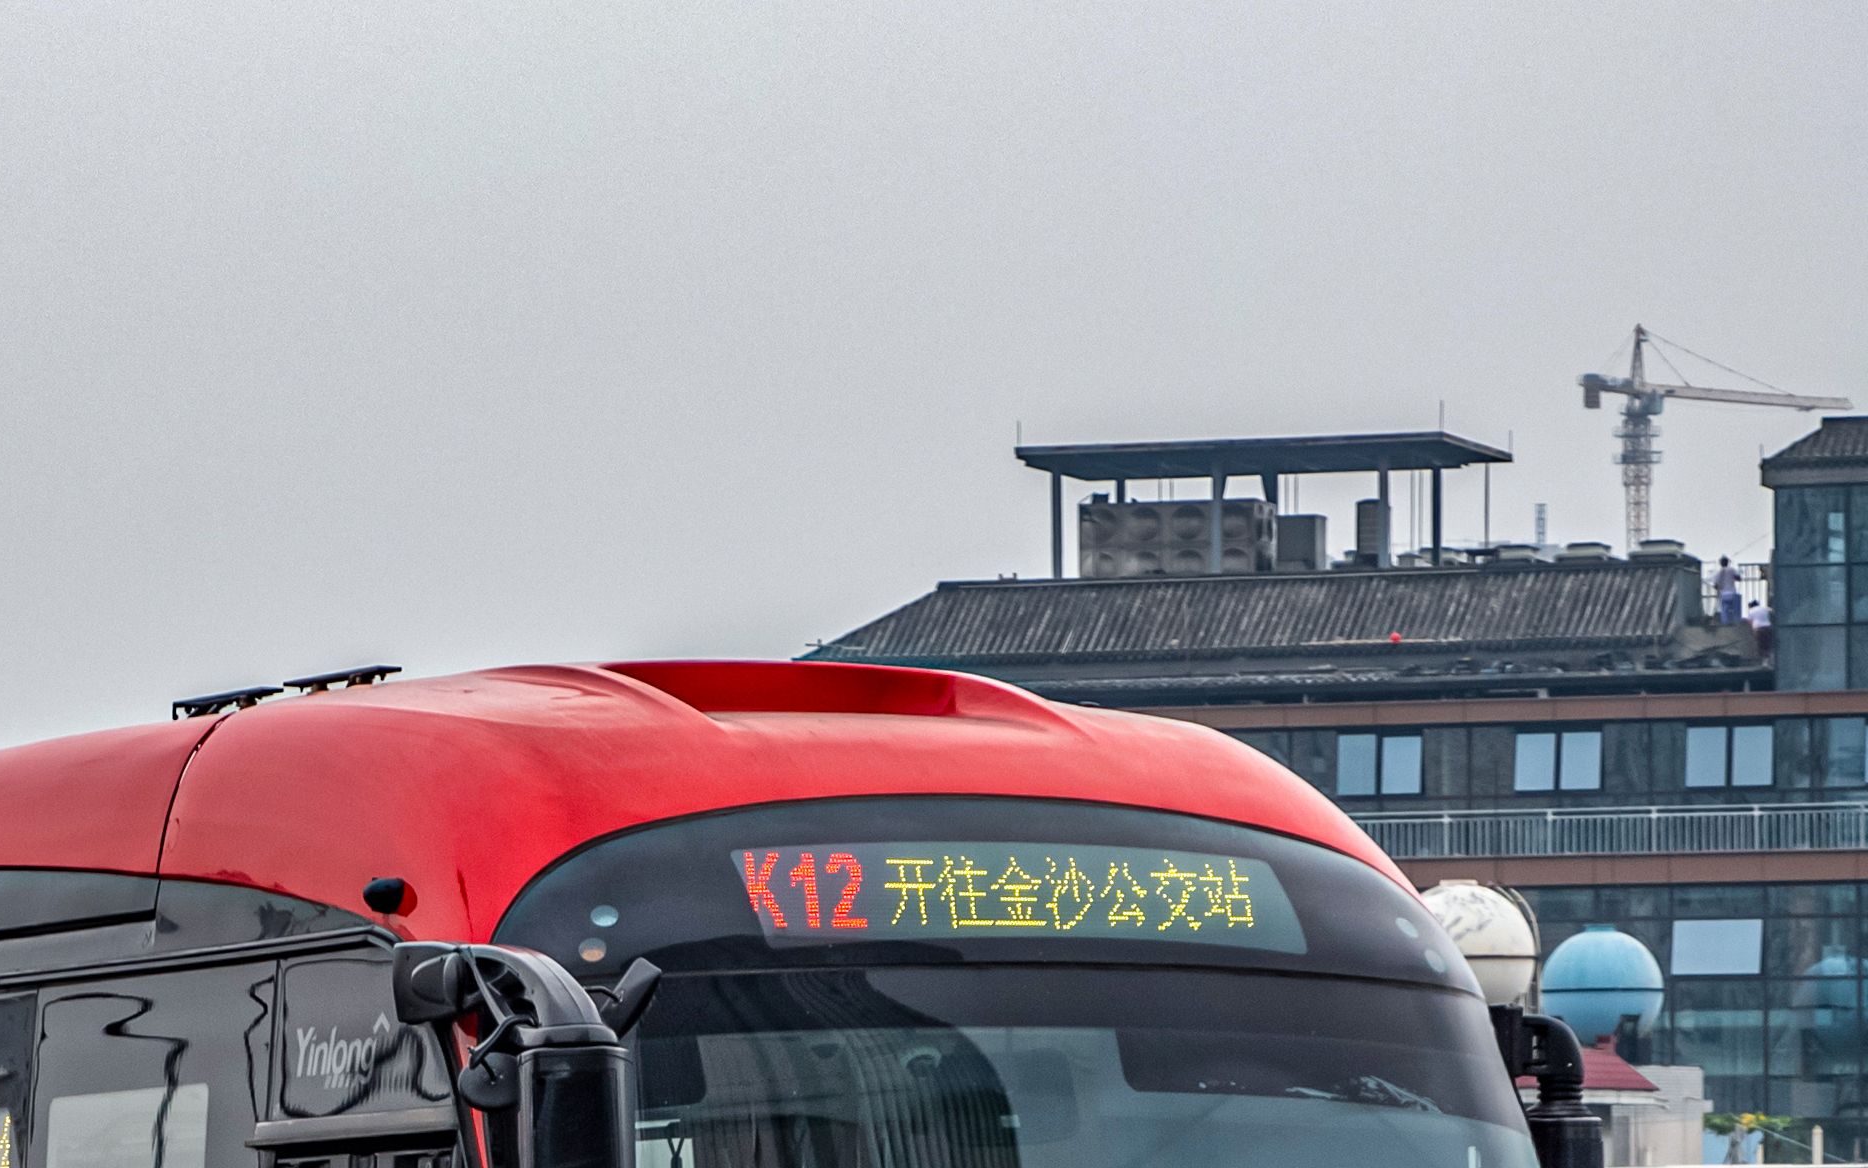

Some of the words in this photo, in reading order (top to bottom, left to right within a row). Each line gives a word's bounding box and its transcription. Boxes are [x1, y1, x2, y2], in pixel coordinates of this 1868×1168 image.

[742, 852, 867, 928] K12
[885, 855, 1254, 930] 开往金沙公交站
[296, 1026, 377, 1085] Yinlong
